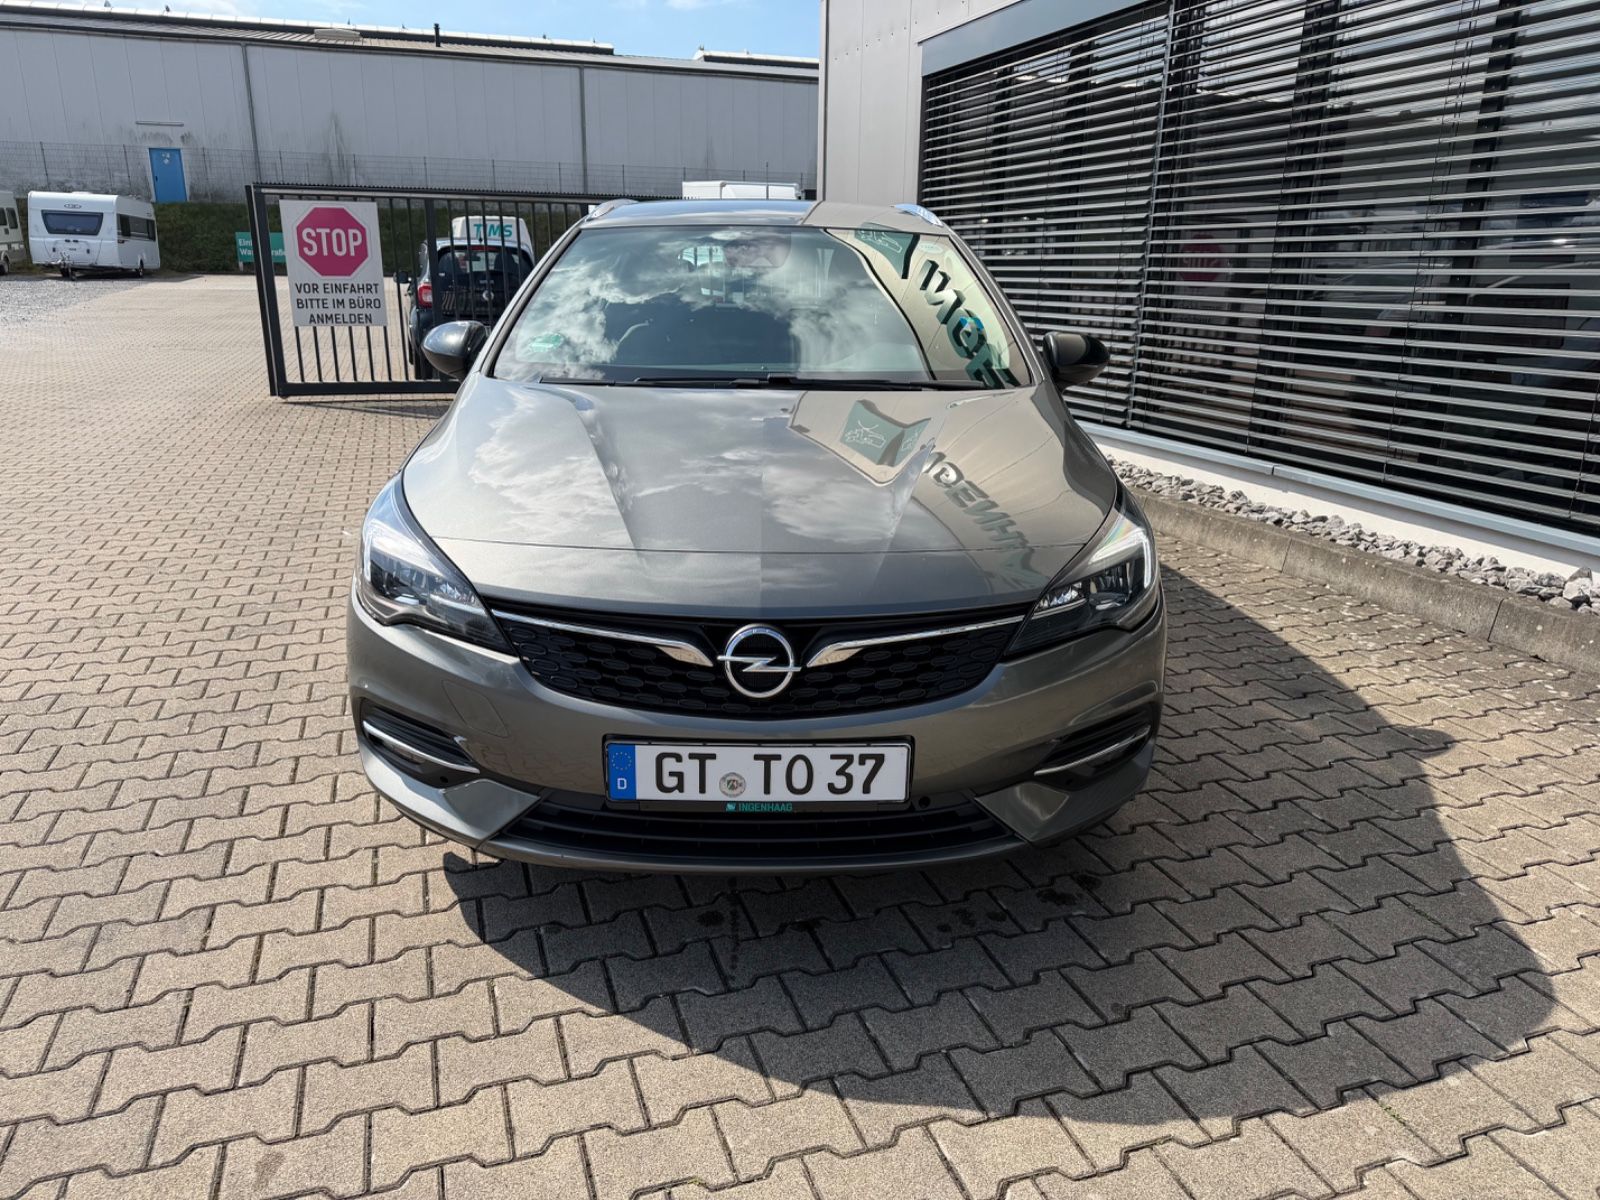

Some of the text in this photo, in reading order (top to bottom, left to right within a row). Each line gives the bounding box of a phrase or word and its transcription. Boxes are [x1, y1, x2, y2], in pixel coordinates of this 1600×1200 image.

[302, 227, 363, 257] STOP
[295, 283, 379, 295] VOR EINFAHRT
[296, 296, 381, 309] BITTE IM BÜRO
[309, 313, 373, 325] ANMELDEN
[655, 752, 717, 794] GT
[753, 754, 814, 795] TO
[827, 754, 885, 794] 37
[617, 778, 627, 790] D
[739, 803, 793, 812] INGENHAAG
